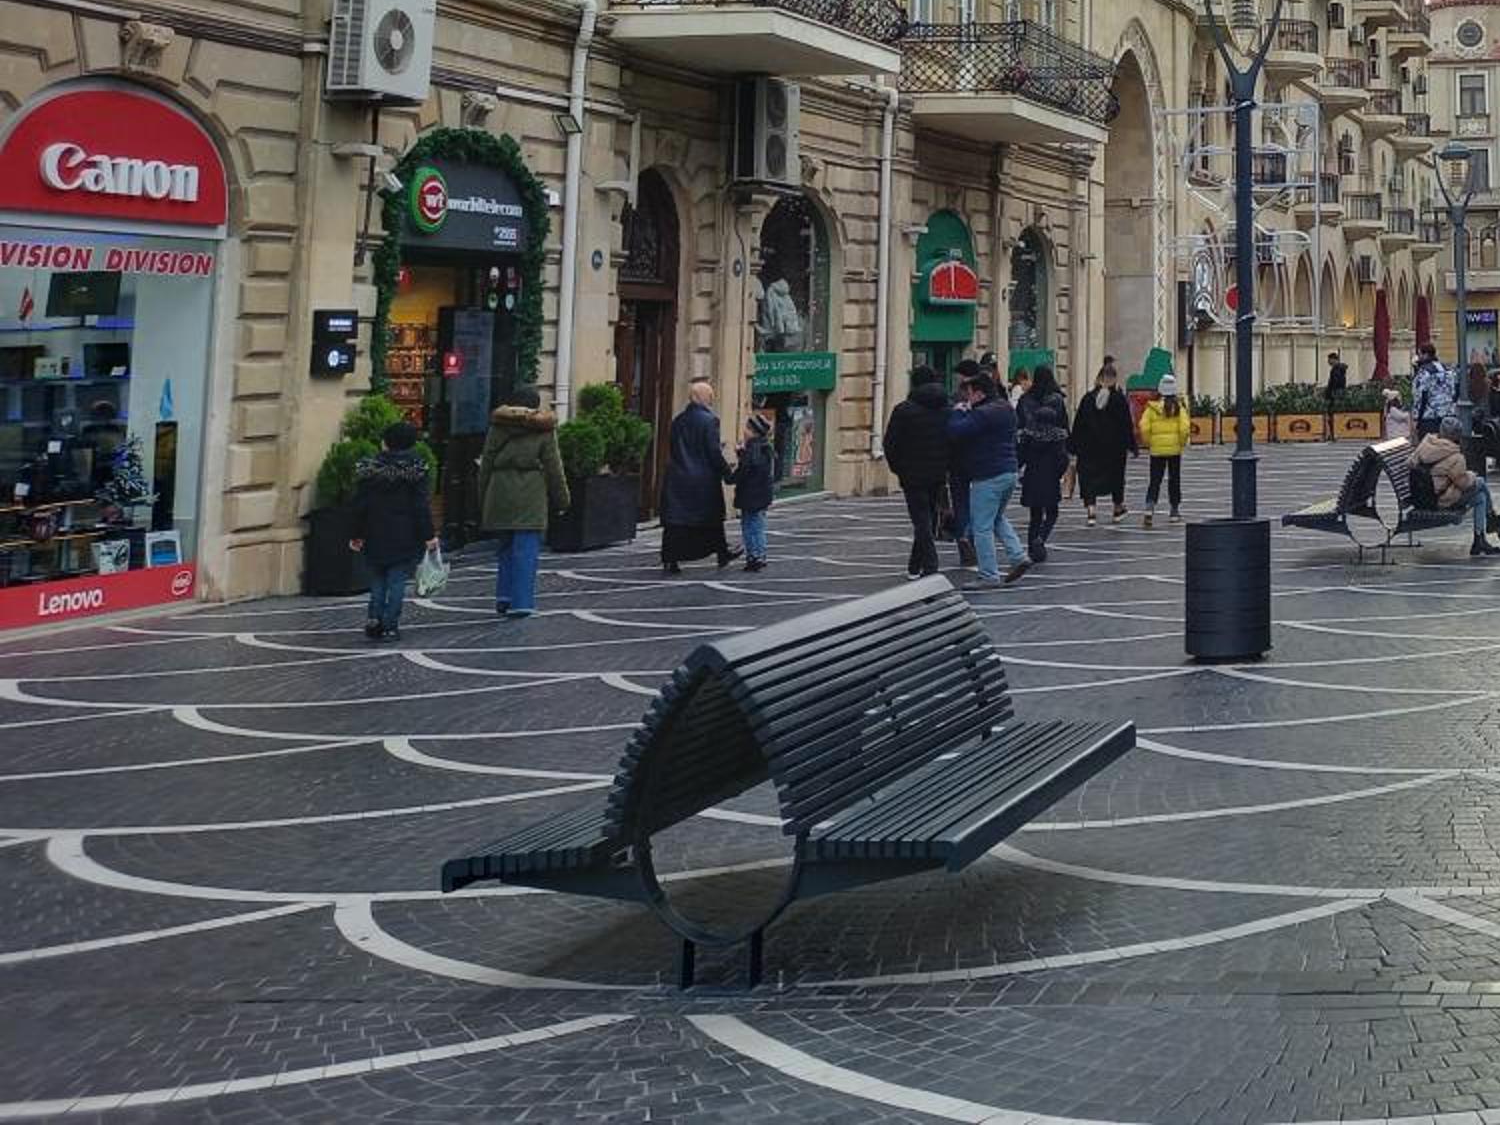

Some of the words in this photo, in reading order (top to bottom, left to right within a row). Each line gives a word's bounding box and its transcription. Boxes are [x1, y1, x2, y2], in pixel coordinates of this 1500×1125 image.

[40, 141, 199, 202] Canon
[0, 242, 93, 270] VISION
[105, 249, 213, 276] DIVISION
[37, 588, 103, 616] Lenovo
